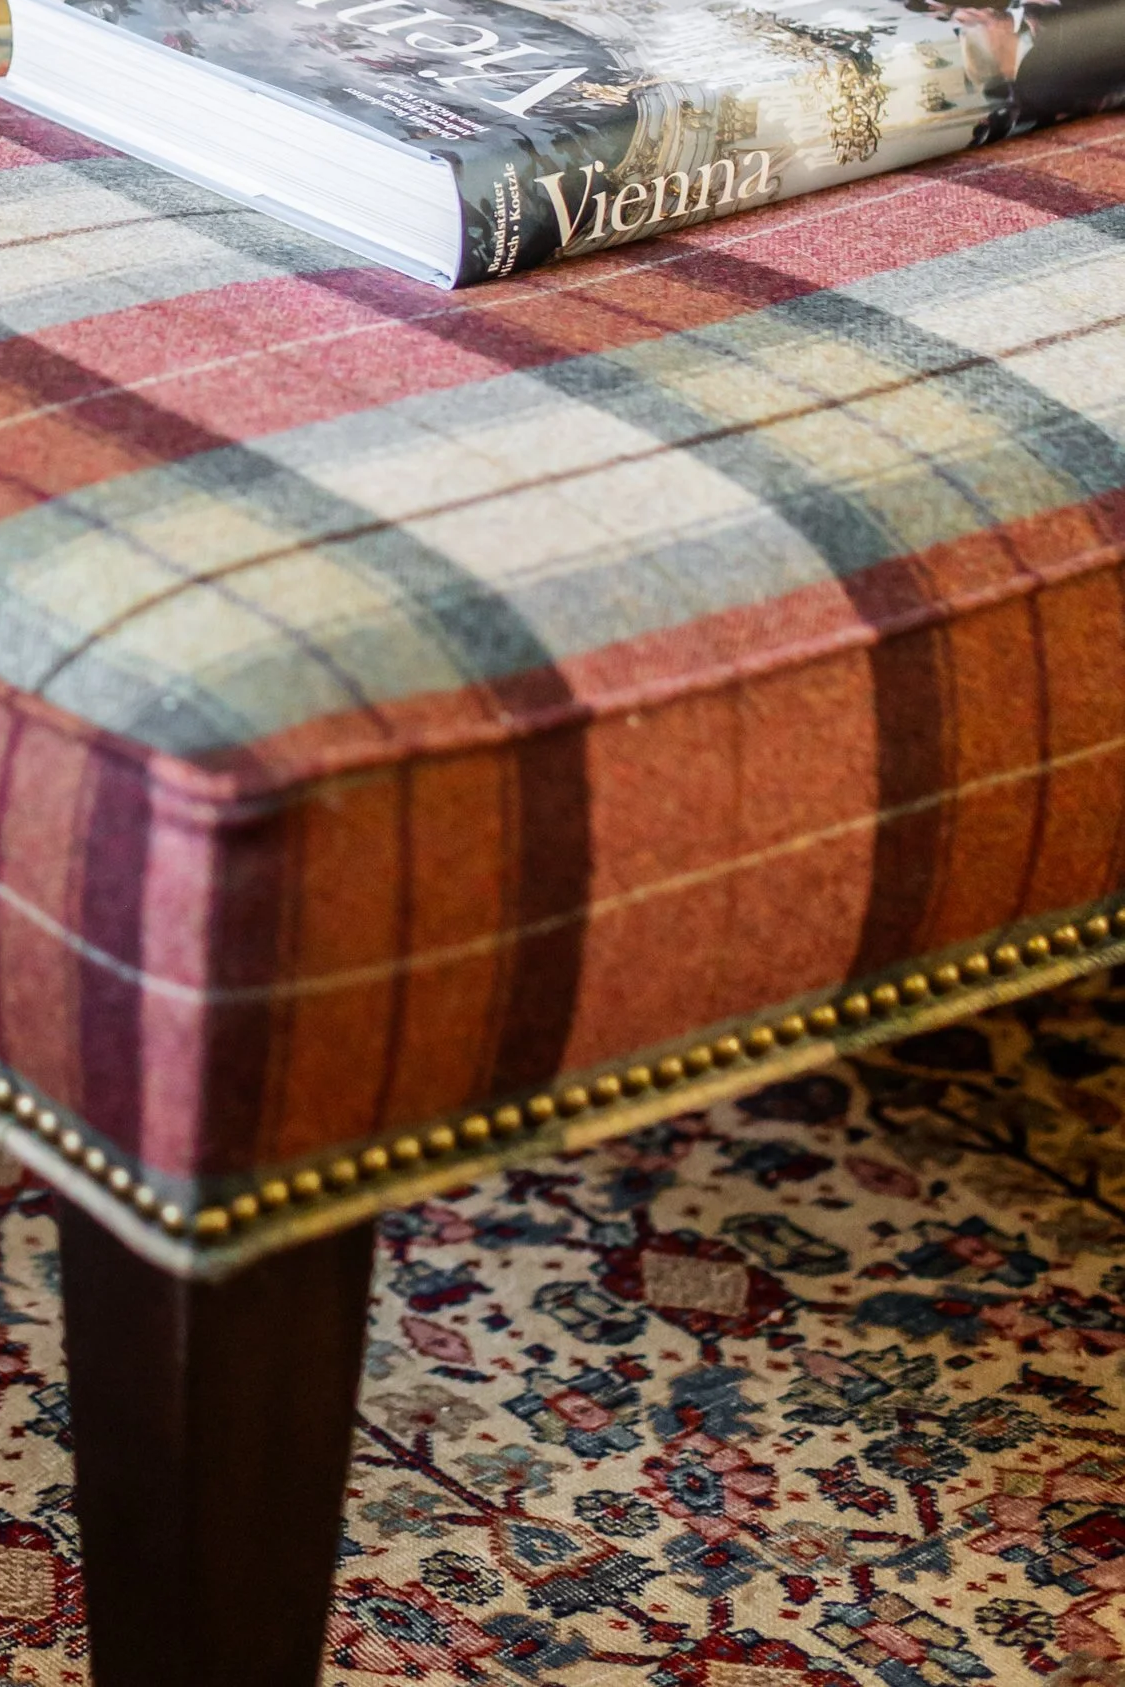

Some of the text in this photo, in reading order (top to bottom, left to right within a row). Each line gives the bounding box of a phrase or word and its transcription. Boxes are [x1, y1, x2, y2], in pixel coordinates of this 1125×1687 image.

[382, 93, 422, 112] Hirsch
[426, 114, 476, 136] Andreas
[487, 181, 507, 273] Brandstätter
[497, 162, 522, 278] Hirsch Koetzle
[534, 150, 773, 247] Vienna
